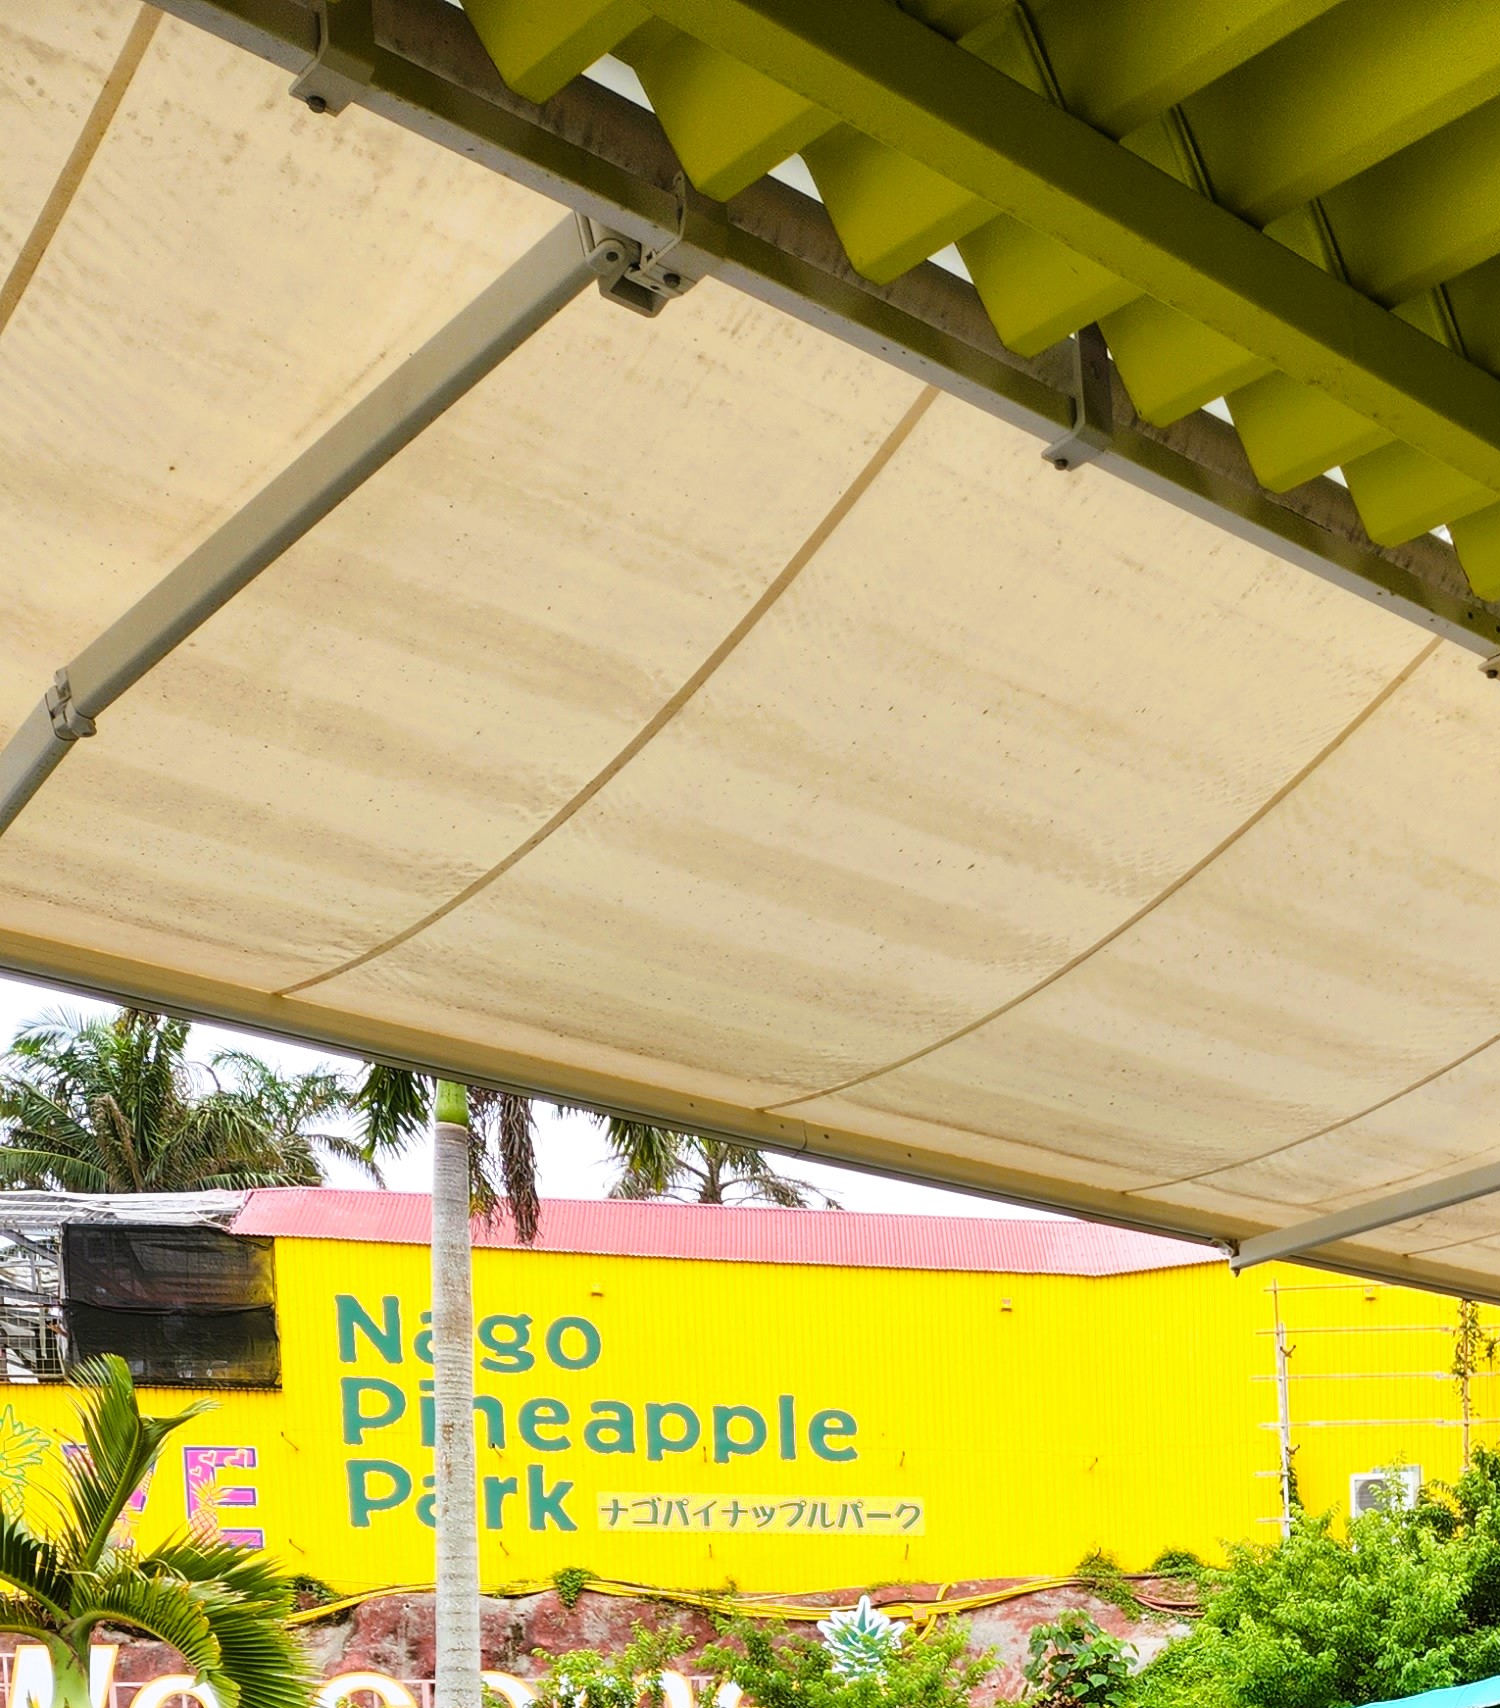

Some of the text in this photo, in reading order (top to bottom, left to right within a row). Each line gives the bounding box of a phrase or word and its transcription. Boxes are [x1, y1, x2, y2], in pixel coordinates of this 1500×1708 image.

[600, 1497, 923, 1529] ナゴパイナップルパーク
